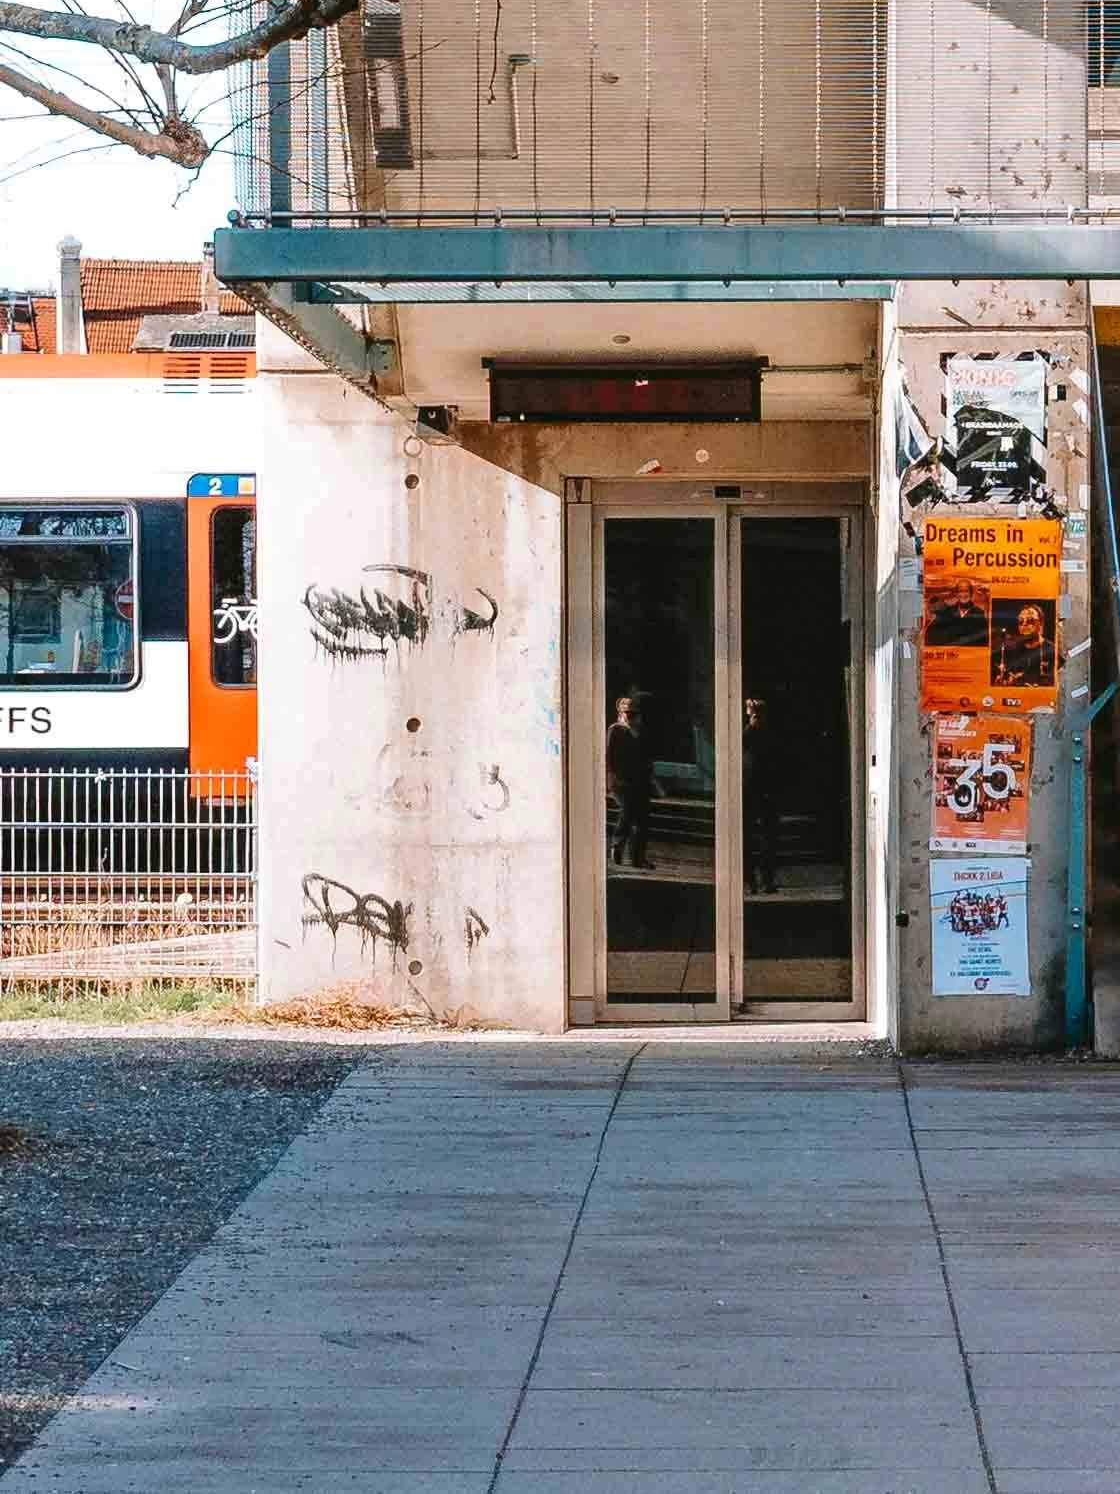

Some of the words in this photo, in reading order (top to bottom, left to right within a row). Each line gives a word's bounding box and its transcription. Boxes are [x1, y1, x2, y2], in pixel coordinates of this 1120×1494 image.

[208, 478, 222, 495] 2
[925, 523, 996, 543] Dreams
[1006, 523, 1024, 543] in
[953, 547, 1057, 568] Percussion
[0, 706, 52, 734] FS
